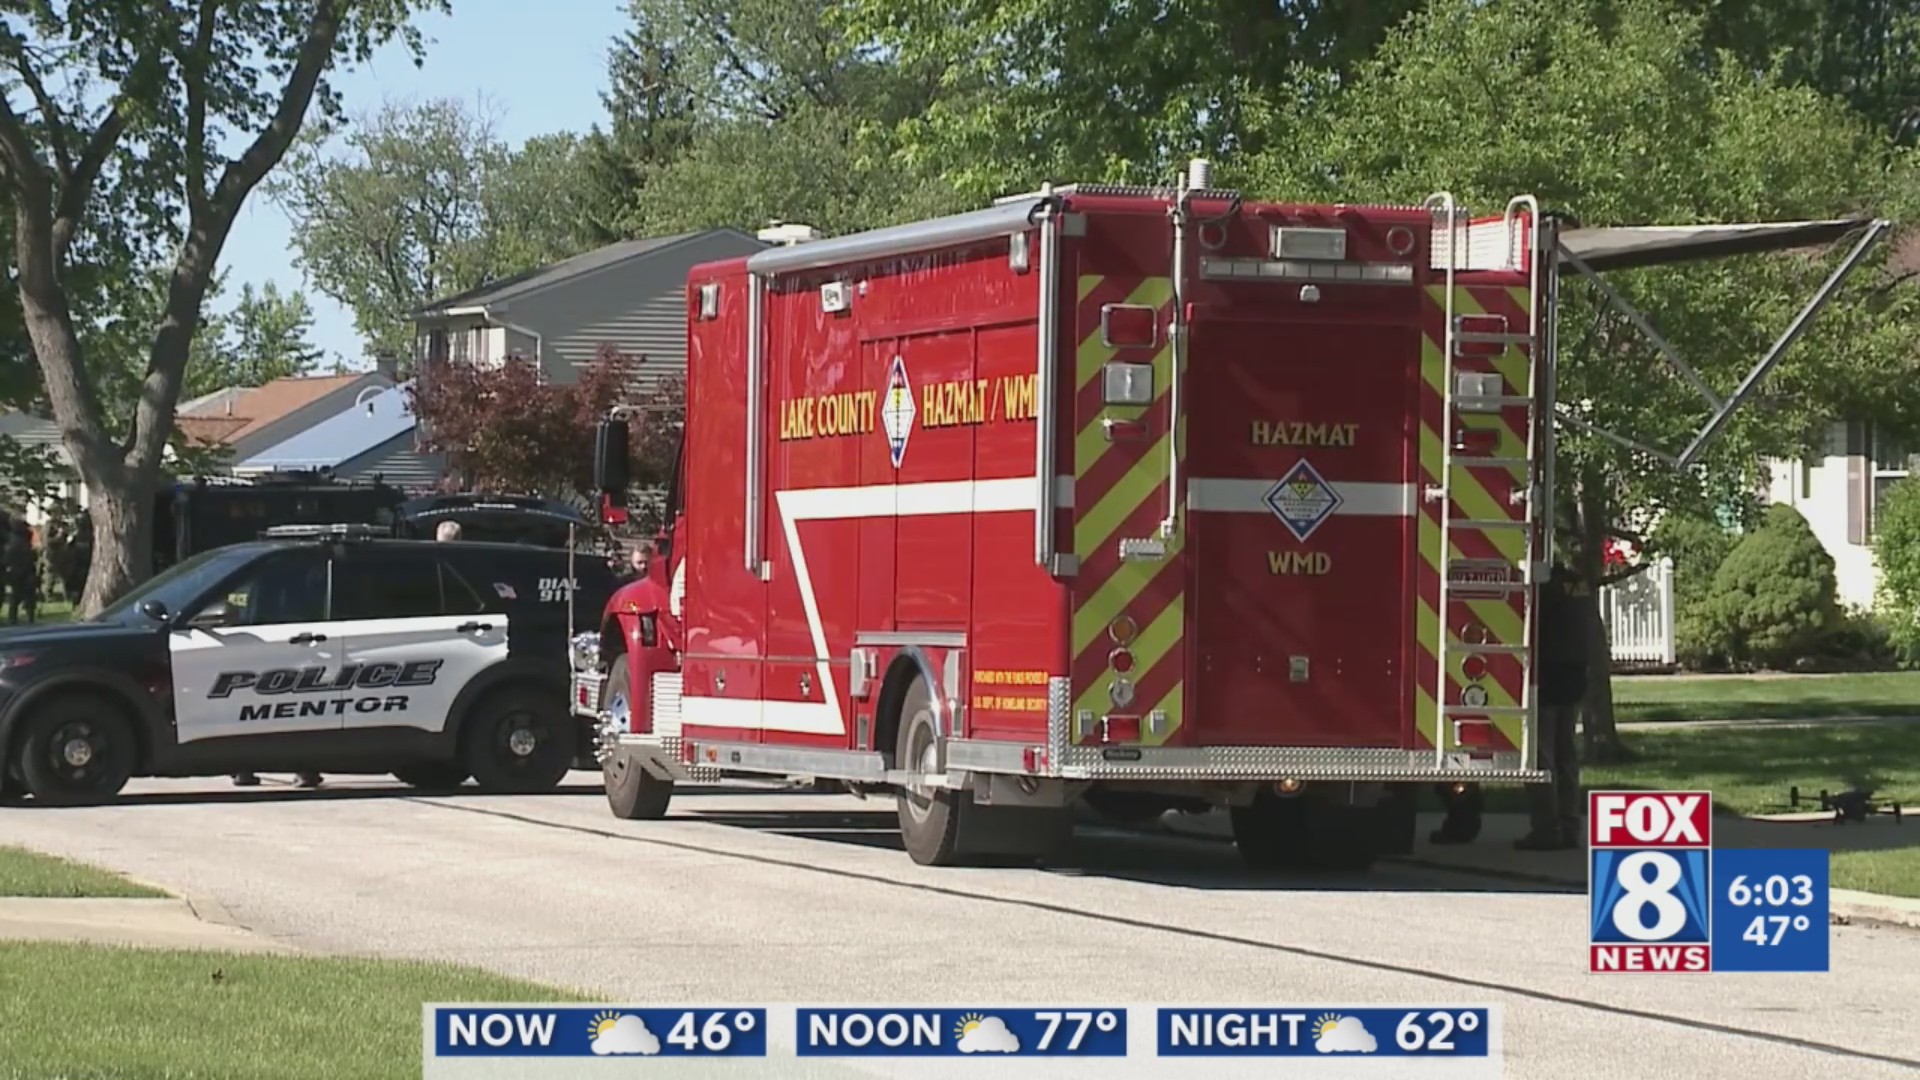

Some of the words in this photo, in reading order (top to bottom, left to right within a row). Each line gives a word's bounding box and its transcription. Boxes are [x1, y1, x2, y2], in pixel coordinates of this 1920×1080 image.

[780, 397, 814, 440] LAKE
[817, 391, 877, 437] COUNTY
[922, 379, 988, 427] HAZMAT
[1252, 420, 1360, 446] HAZMAT
[1268, 550, 1332, 575] WMD
[538, 577, 581, 590] DIAL
[539, 589, 573, 602] 911
[207, 658, 445, 699] POLICE
[239, 695, 409, 721] MENTOR
